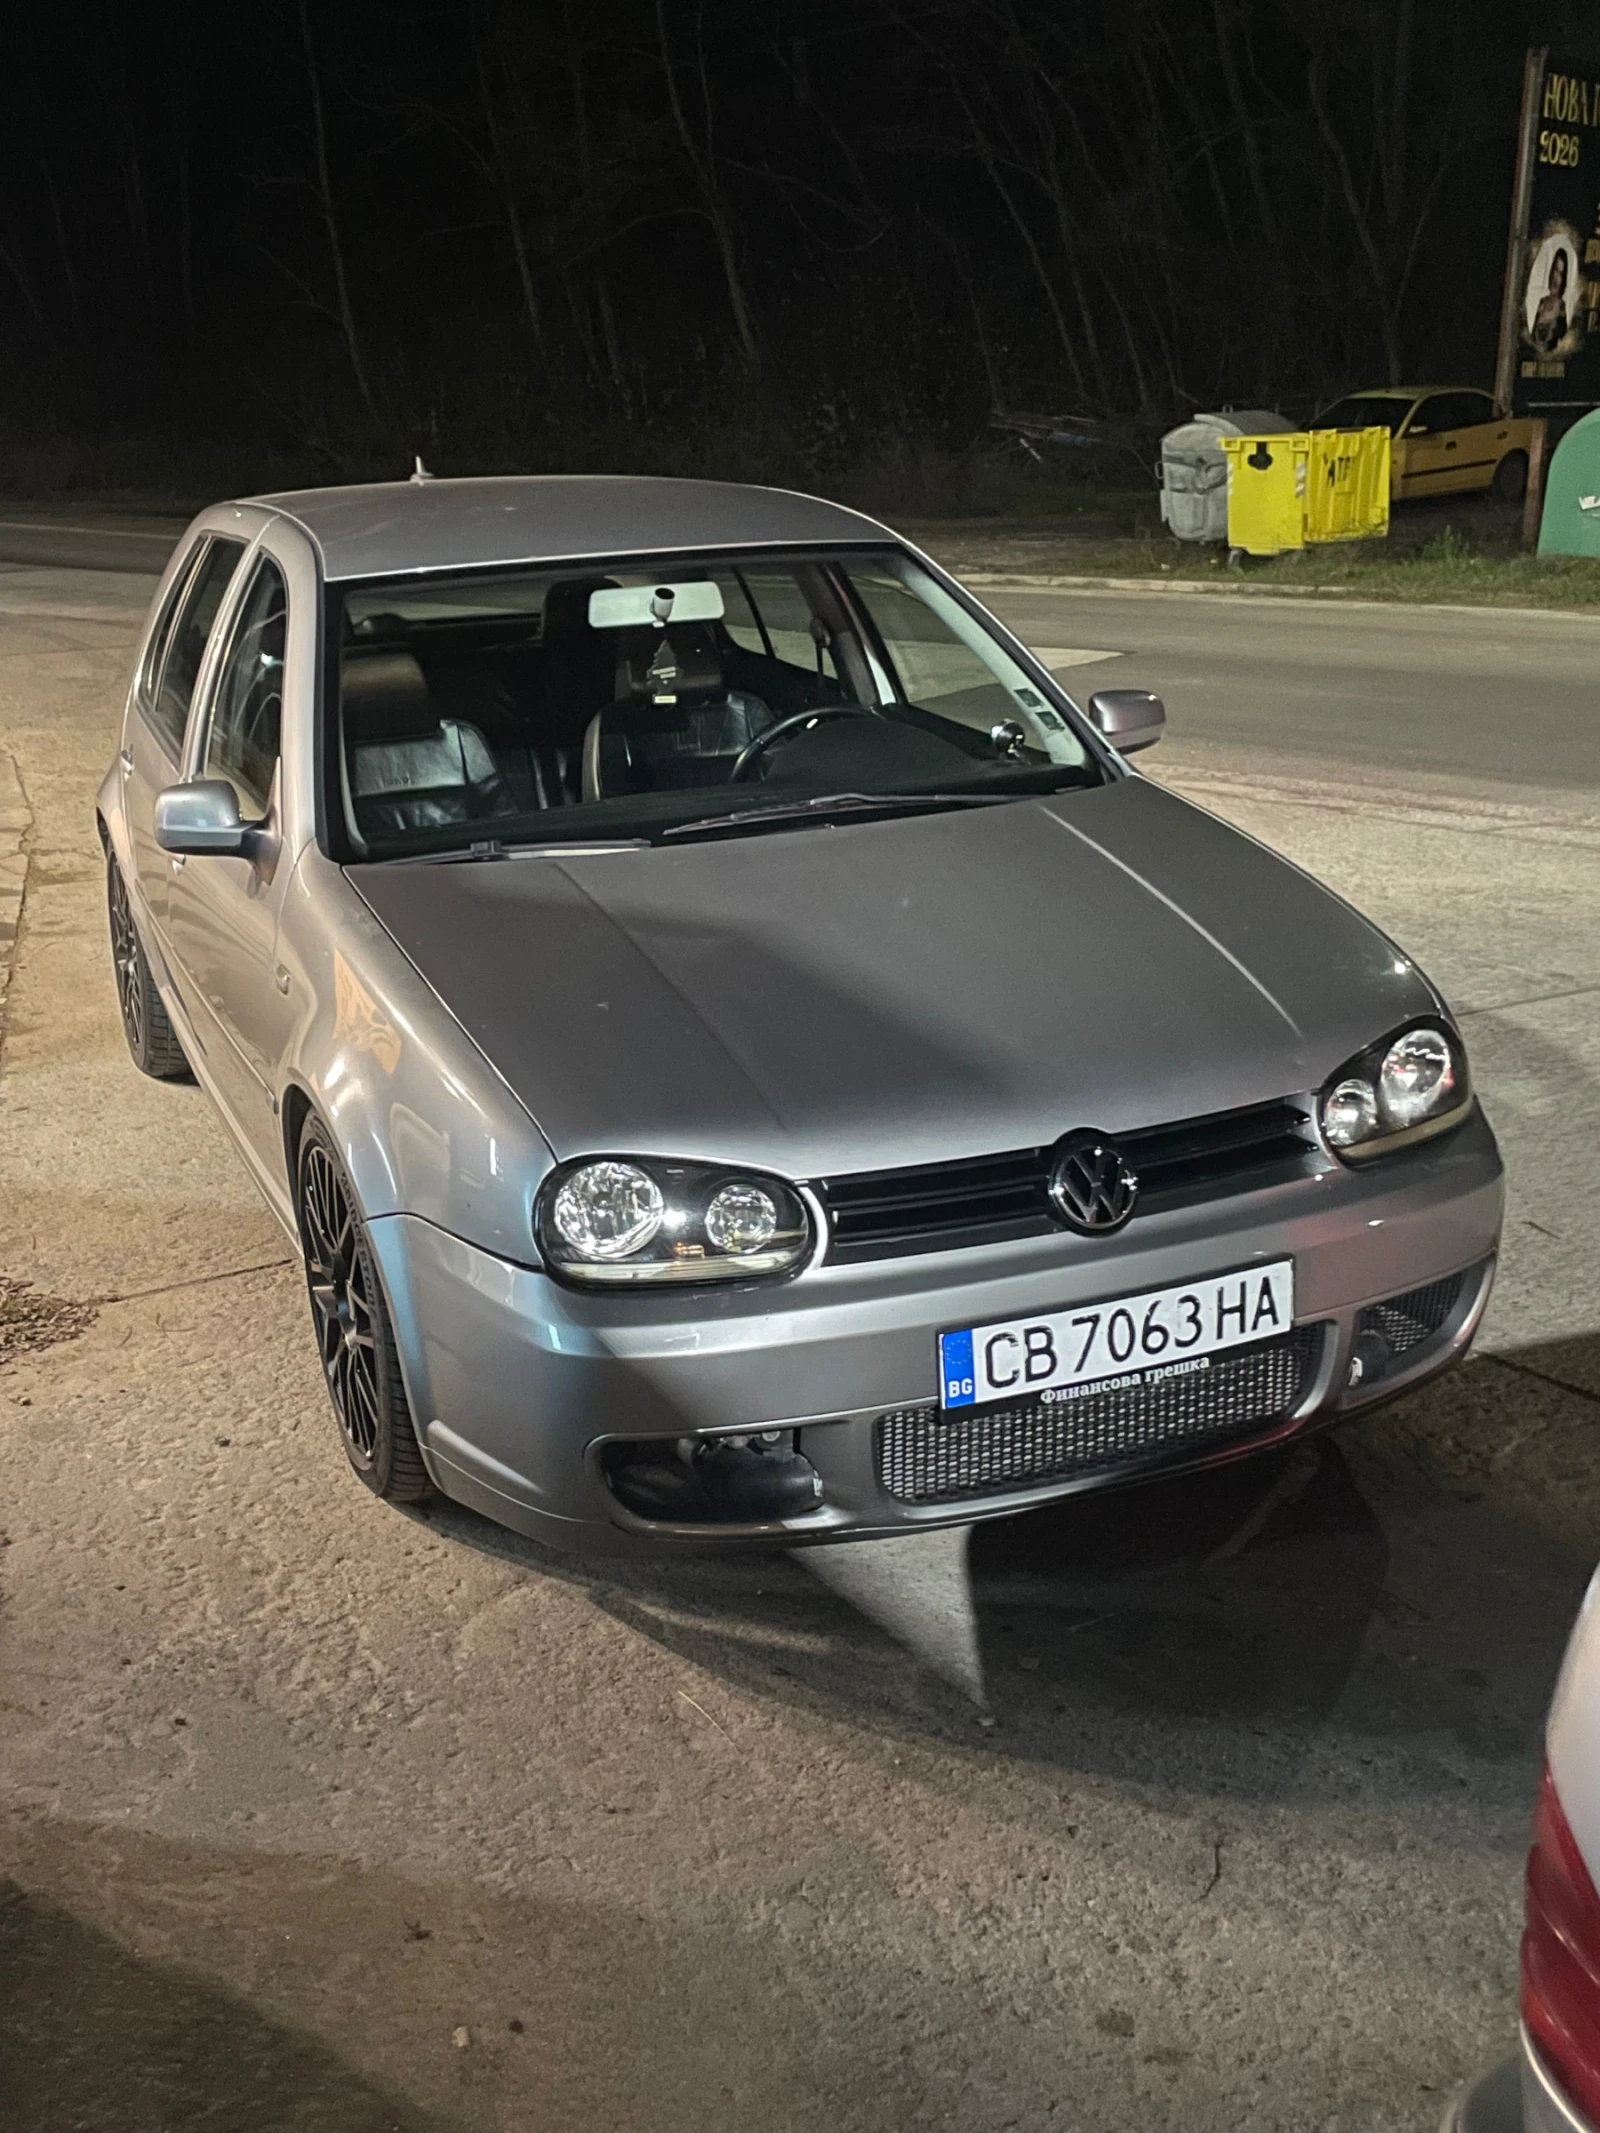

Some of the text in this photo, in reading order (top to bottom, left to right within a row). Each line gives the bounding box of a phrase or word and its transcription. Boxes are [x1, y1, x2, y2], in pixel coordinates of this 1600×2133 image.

[1539, 130, 1579, 167] 2026
[985, 1275, 1279, 1389] CB 7063 HA
[948, 1380, 973, 1398] BG
[1040, 1356, 1210, 1404] Финансова грешка
